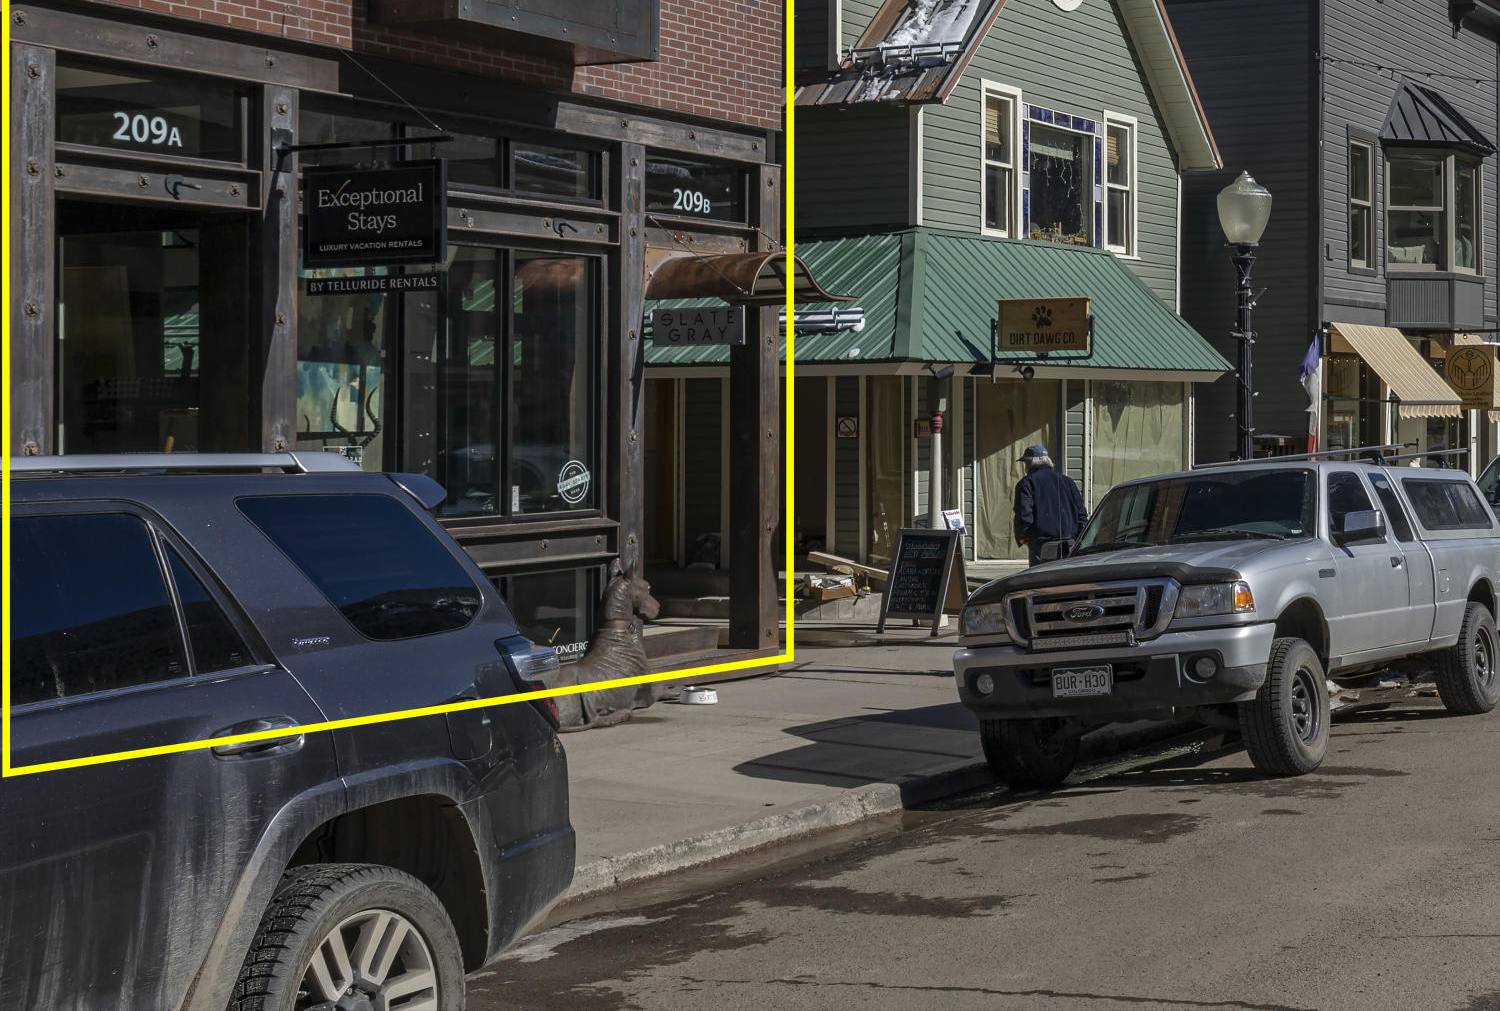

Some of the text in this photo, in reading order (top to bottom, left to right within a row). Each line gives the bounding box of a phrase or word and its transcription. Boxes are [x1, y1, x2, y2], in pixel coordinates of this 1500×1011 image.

[112, 111, 183, 148] 209A
[318, 182, 424, 210] Exceptional
[672, 188, 711, 214] 209B
[347, 212, 397, 234] Stays
[320, 240, 423, 252] LUXURY VACATION RENTALS
[310, 276, 438, 292] BY TELLURIDE RENTALS
[661, 310, 736, 327] SLATE
[668, 326, 727, 342] GRAY
[1009, 333, 1031, 346] DIRT
[1034, 332, 1061, 345] DAWG
[1070, 606, 1093, 619] Ford
